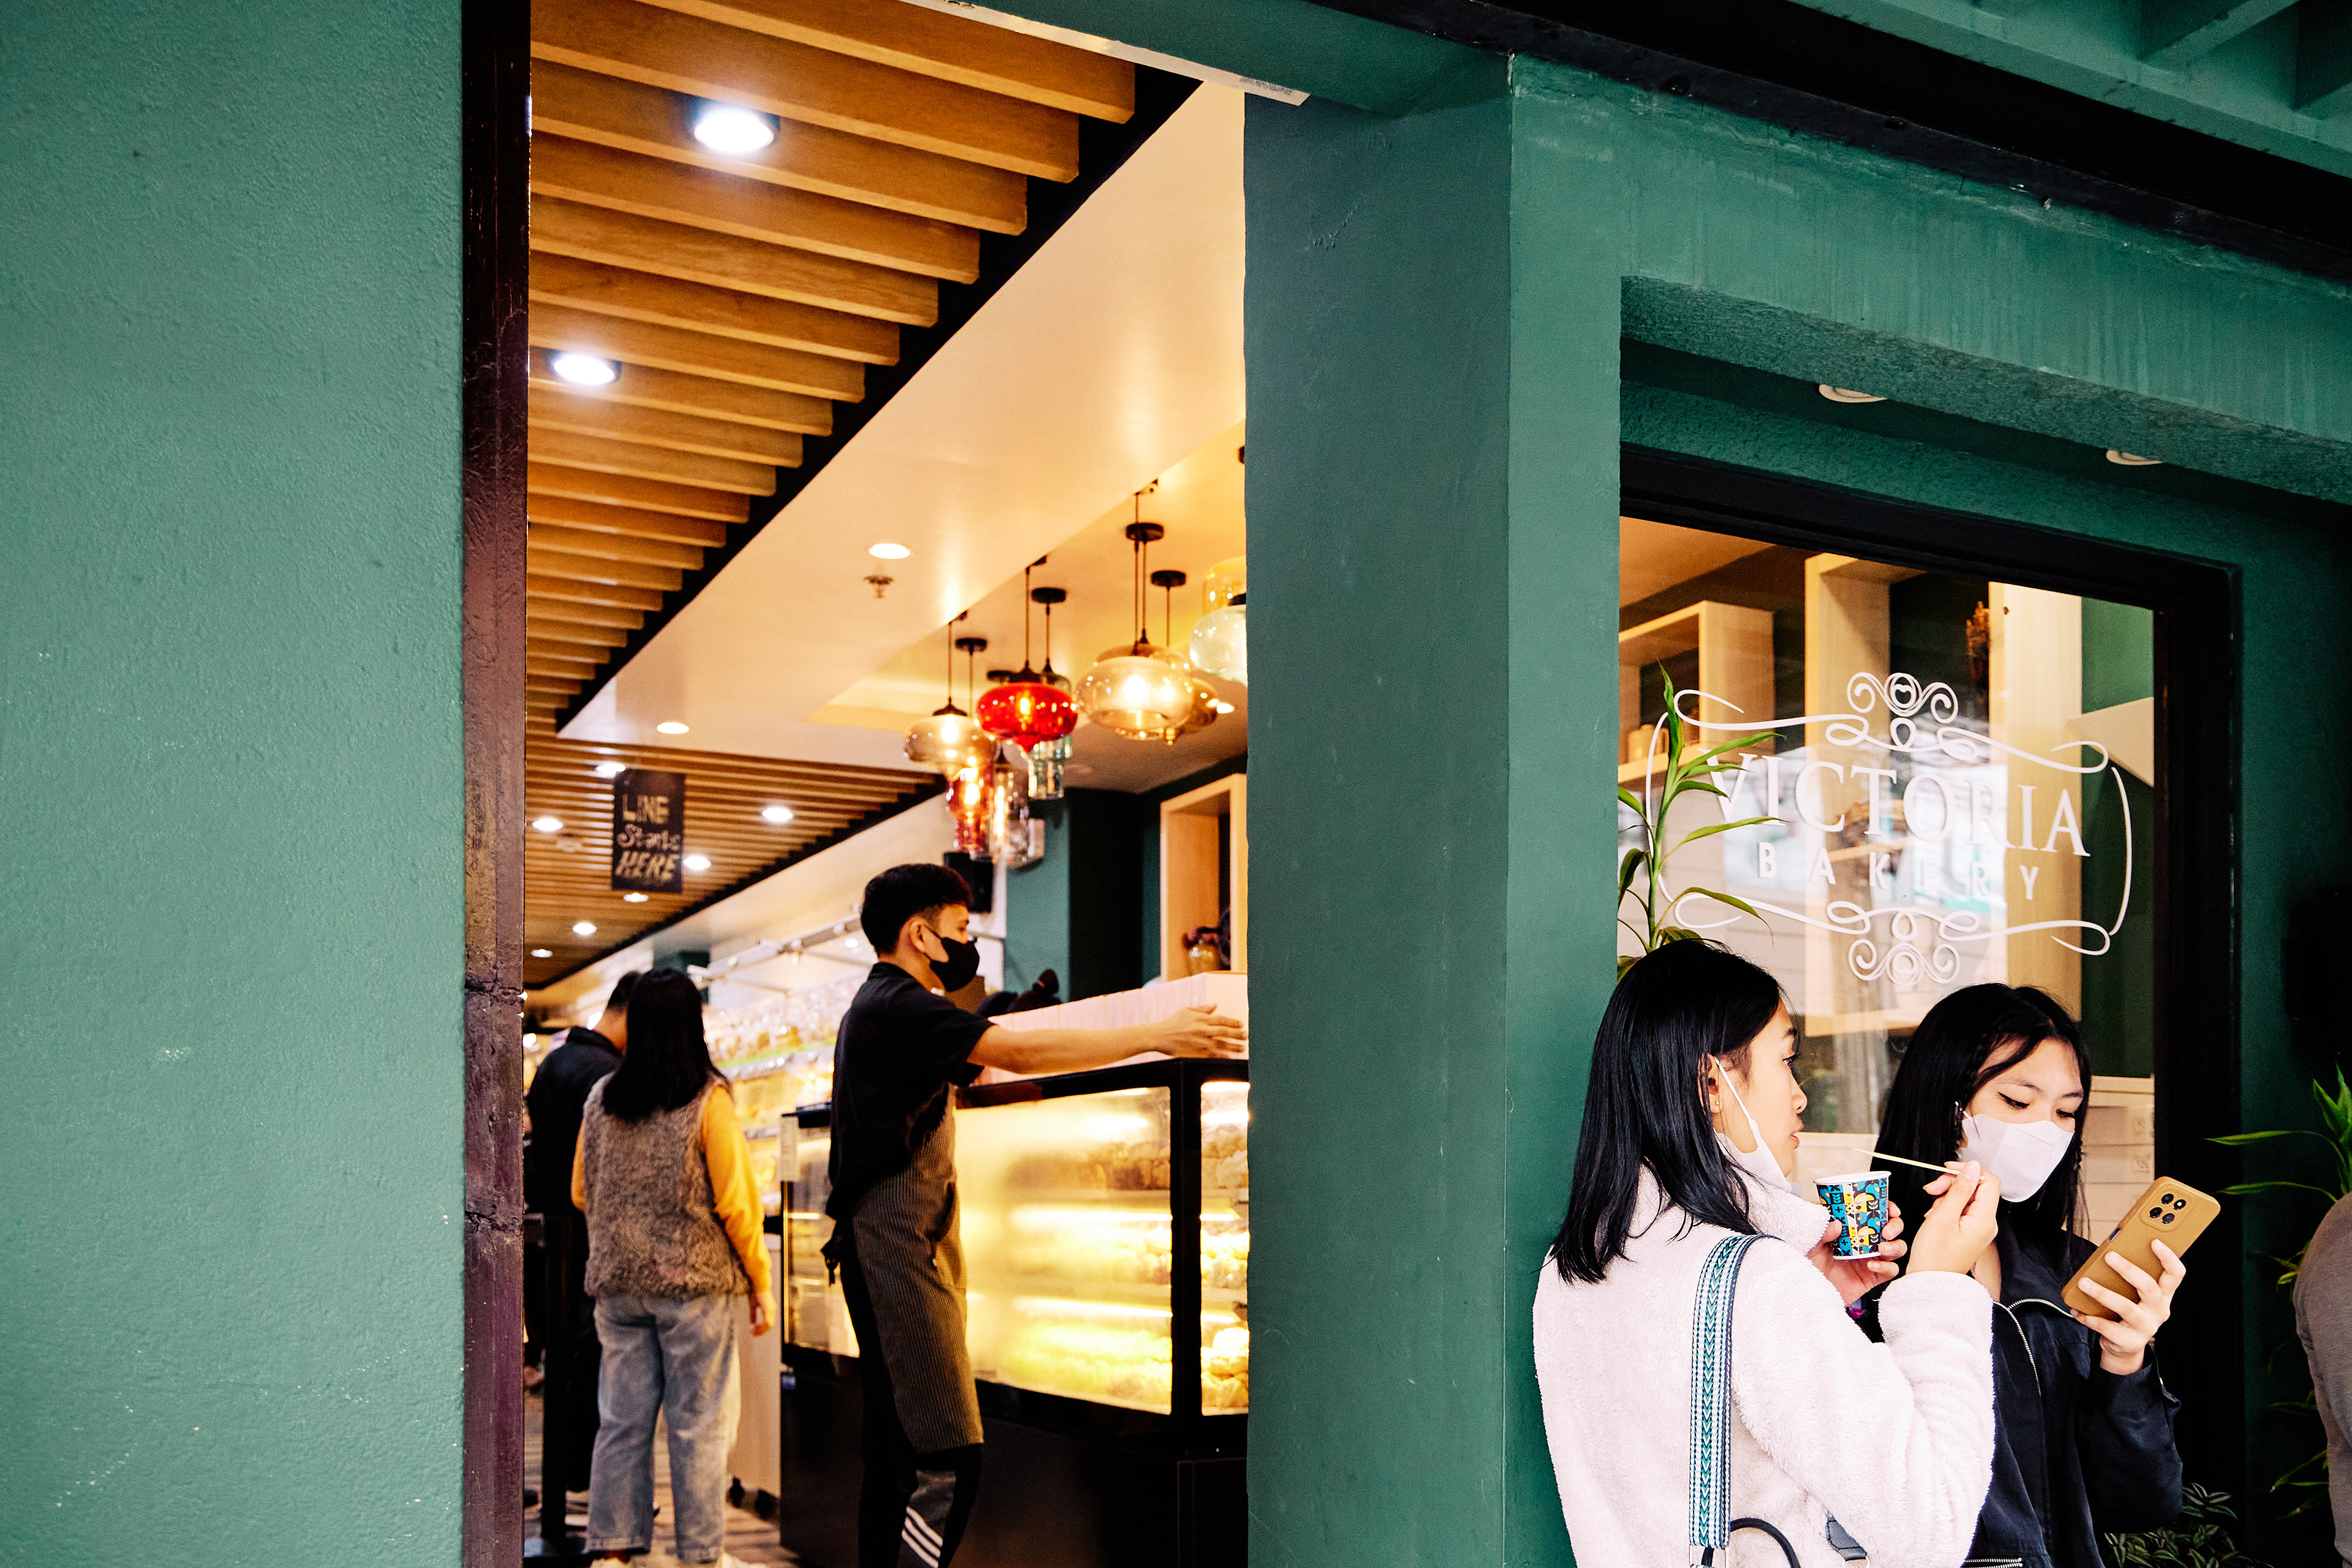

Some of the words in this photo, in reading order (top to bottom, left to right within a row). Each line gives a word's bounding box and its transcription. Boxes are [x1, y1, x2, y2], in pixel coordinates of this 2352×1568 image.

[622, 794, 670, 824] LINE
[1697, 748, 2091, 858] VICTORIA
[615, 851, 680, 882] HERE
[1758, 841, 2040, 901] BAKERY
